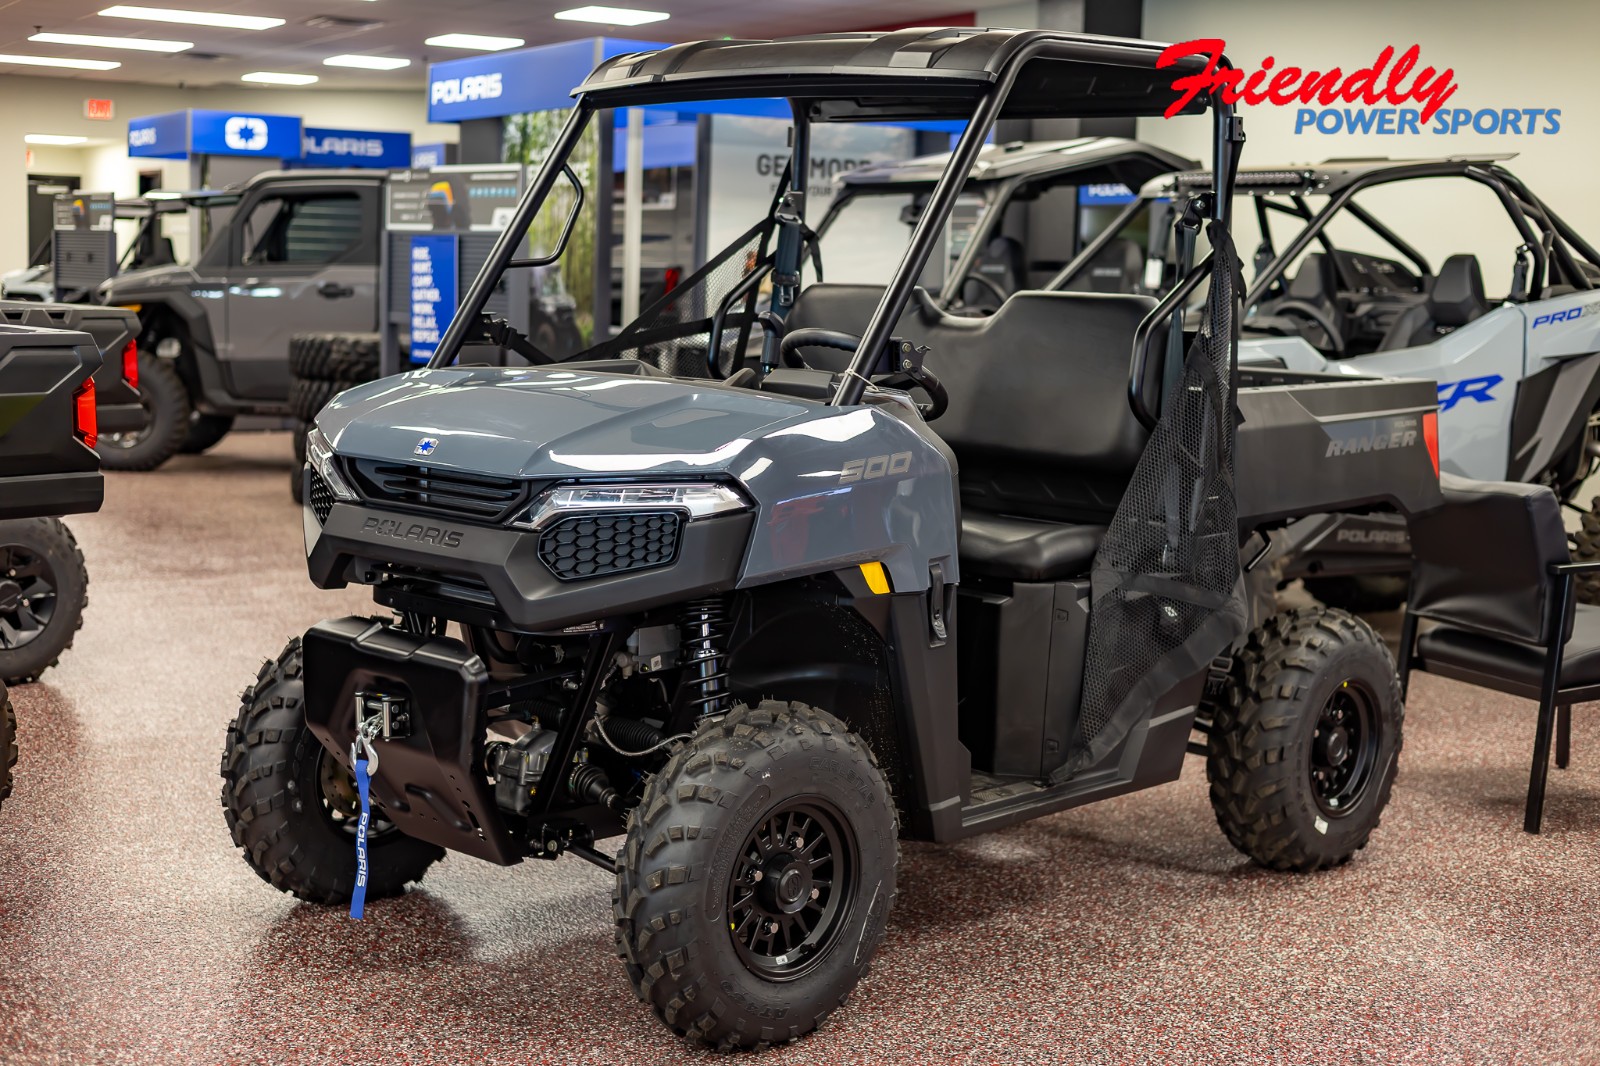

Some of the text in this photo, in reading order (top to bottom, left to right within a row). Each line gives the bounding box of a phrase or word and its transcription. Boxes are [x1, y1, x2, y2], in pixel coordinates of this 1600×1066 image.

[431, 72, 503, 106] POLARIS
[810, 157, 871, 179] MOR
[1437, 374, 1504, 413] ZR
[1325, 430, 1417, 458] RANGER
[838, 451, 912, 484] 500
[361, 516, 464, 549] POLARIS
[1337, 529, 1406, 543] POLARIS
[357, 812, 369, 888] POLARIS
